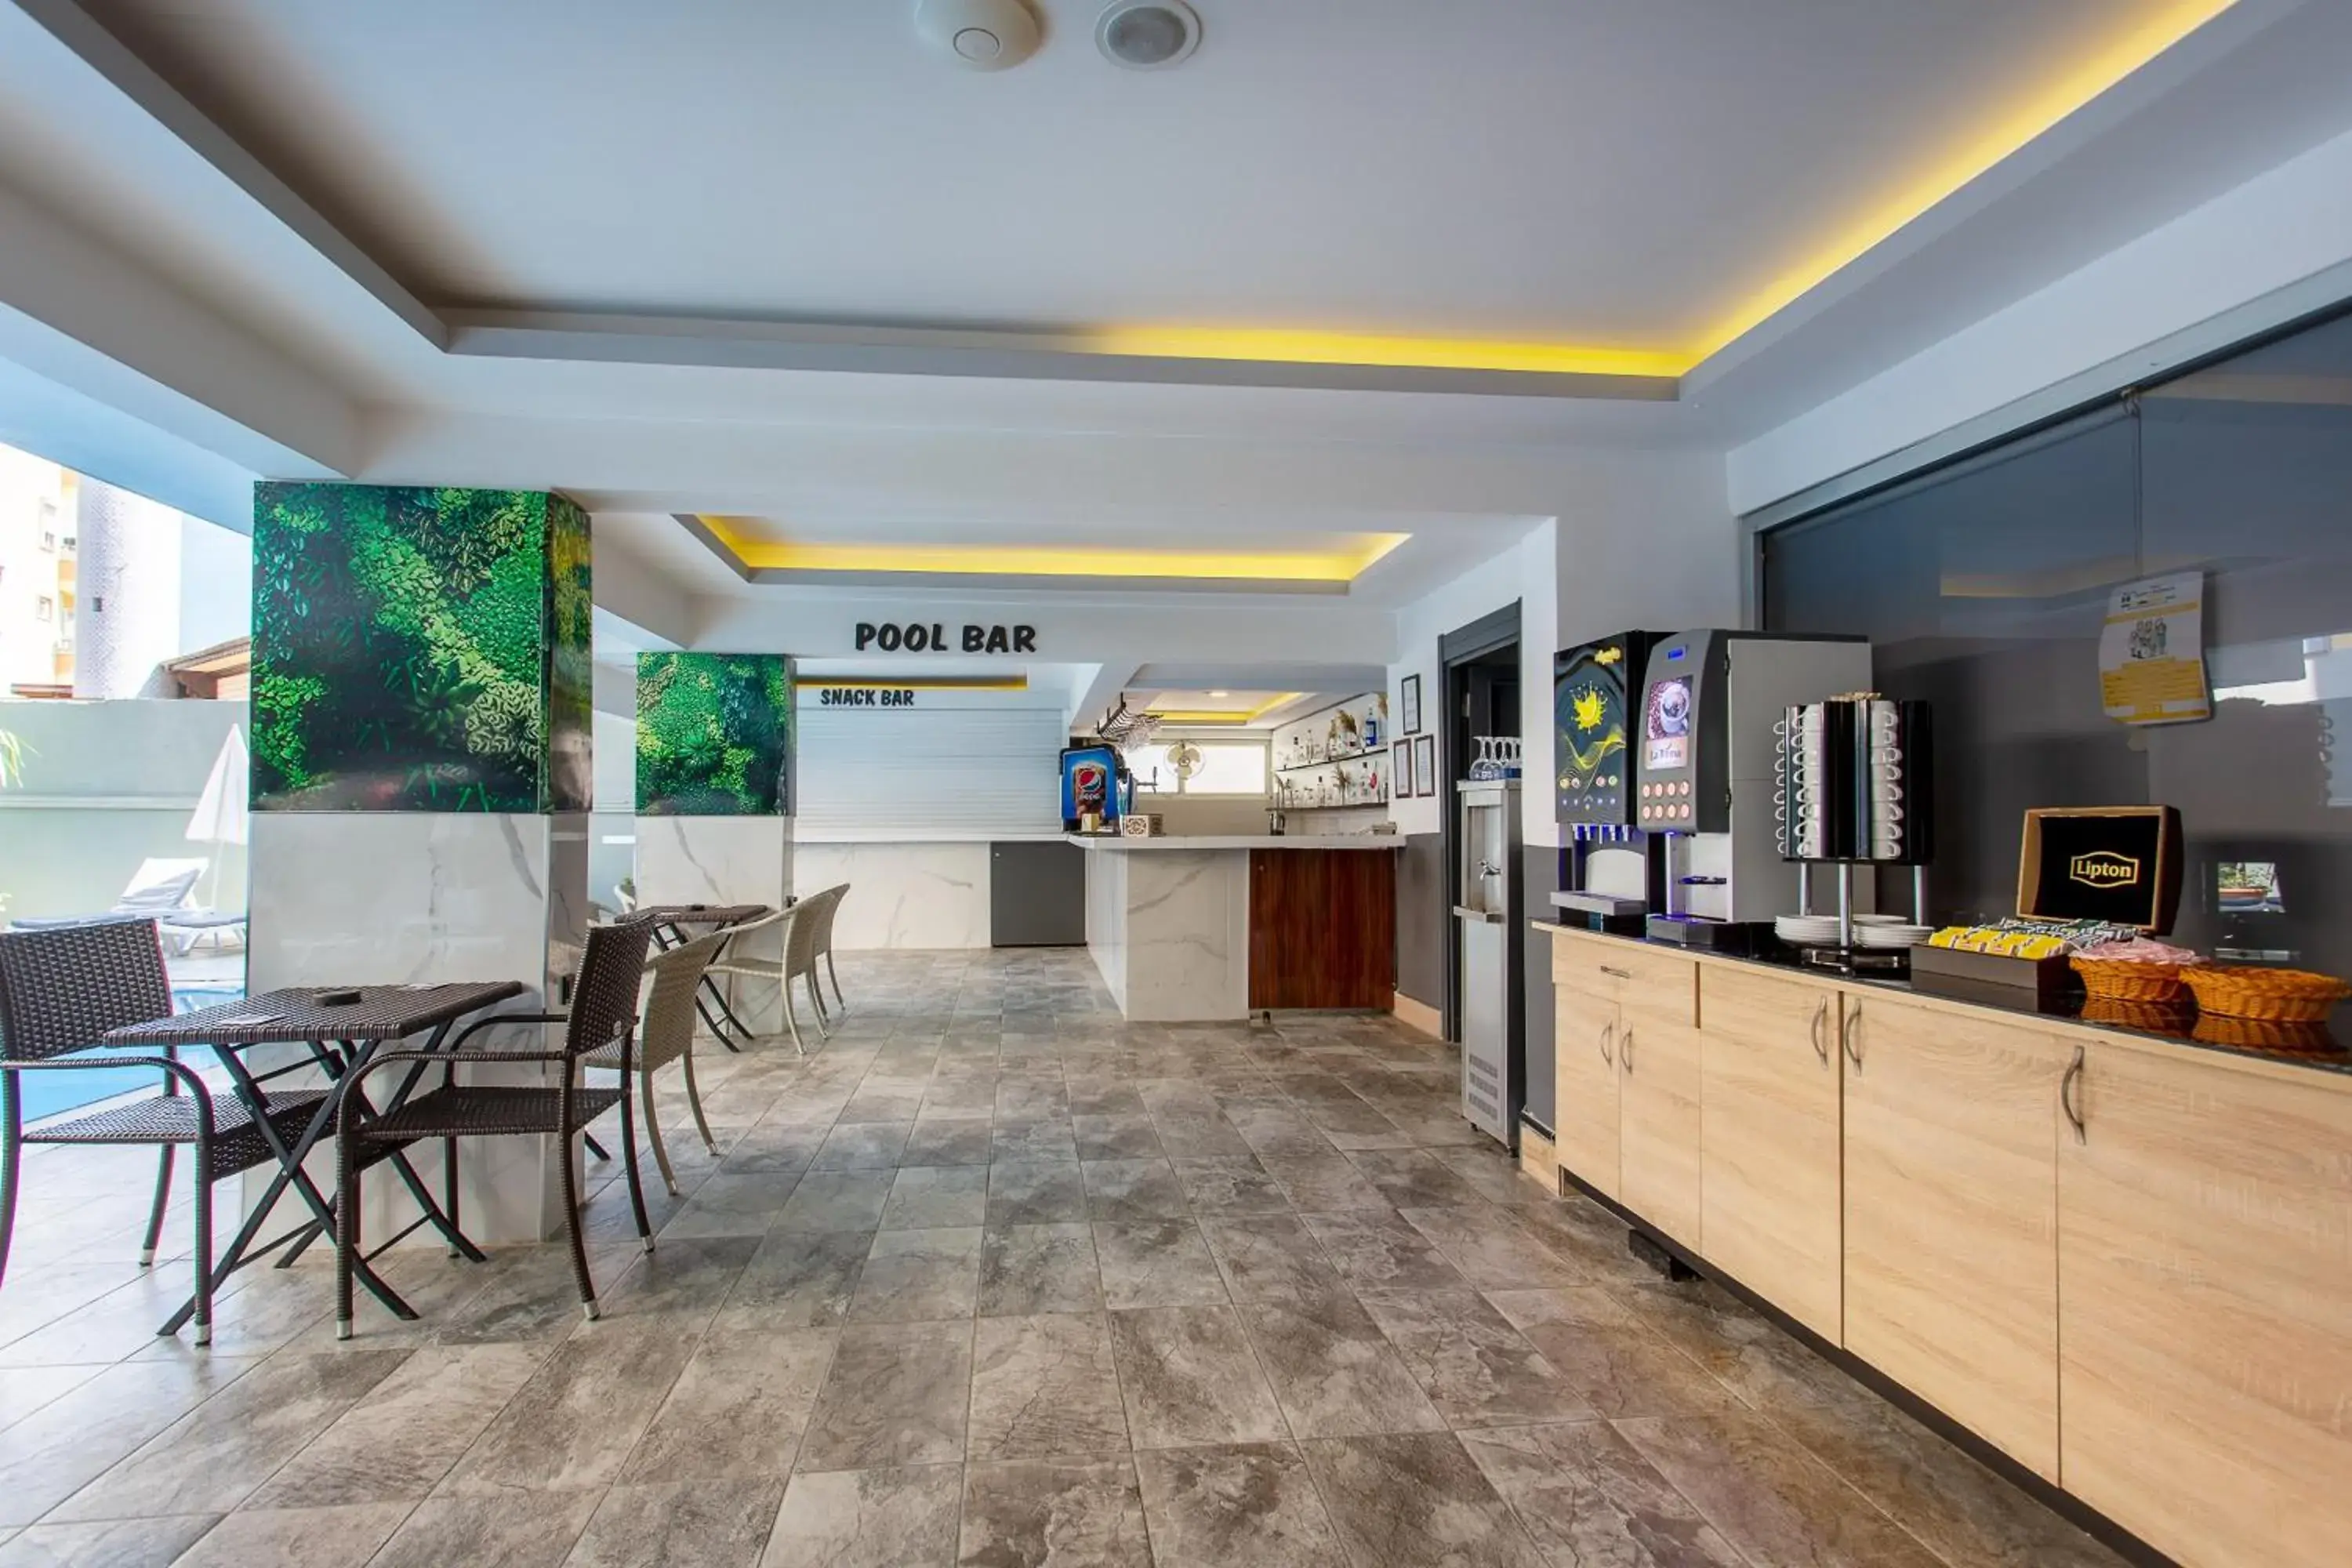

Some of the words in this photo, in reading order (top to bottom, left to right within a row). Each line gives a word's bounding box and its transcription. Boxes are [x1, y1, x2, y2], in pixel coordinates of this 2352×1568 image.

[855, 623, 948, 652] POOL
[962, 625, 1036, 654] BAR
[821, 688, 876, 706] SNACK
[880, 689, 914, 706] BAR
[2076, 860, 2132, 880] Lipton
